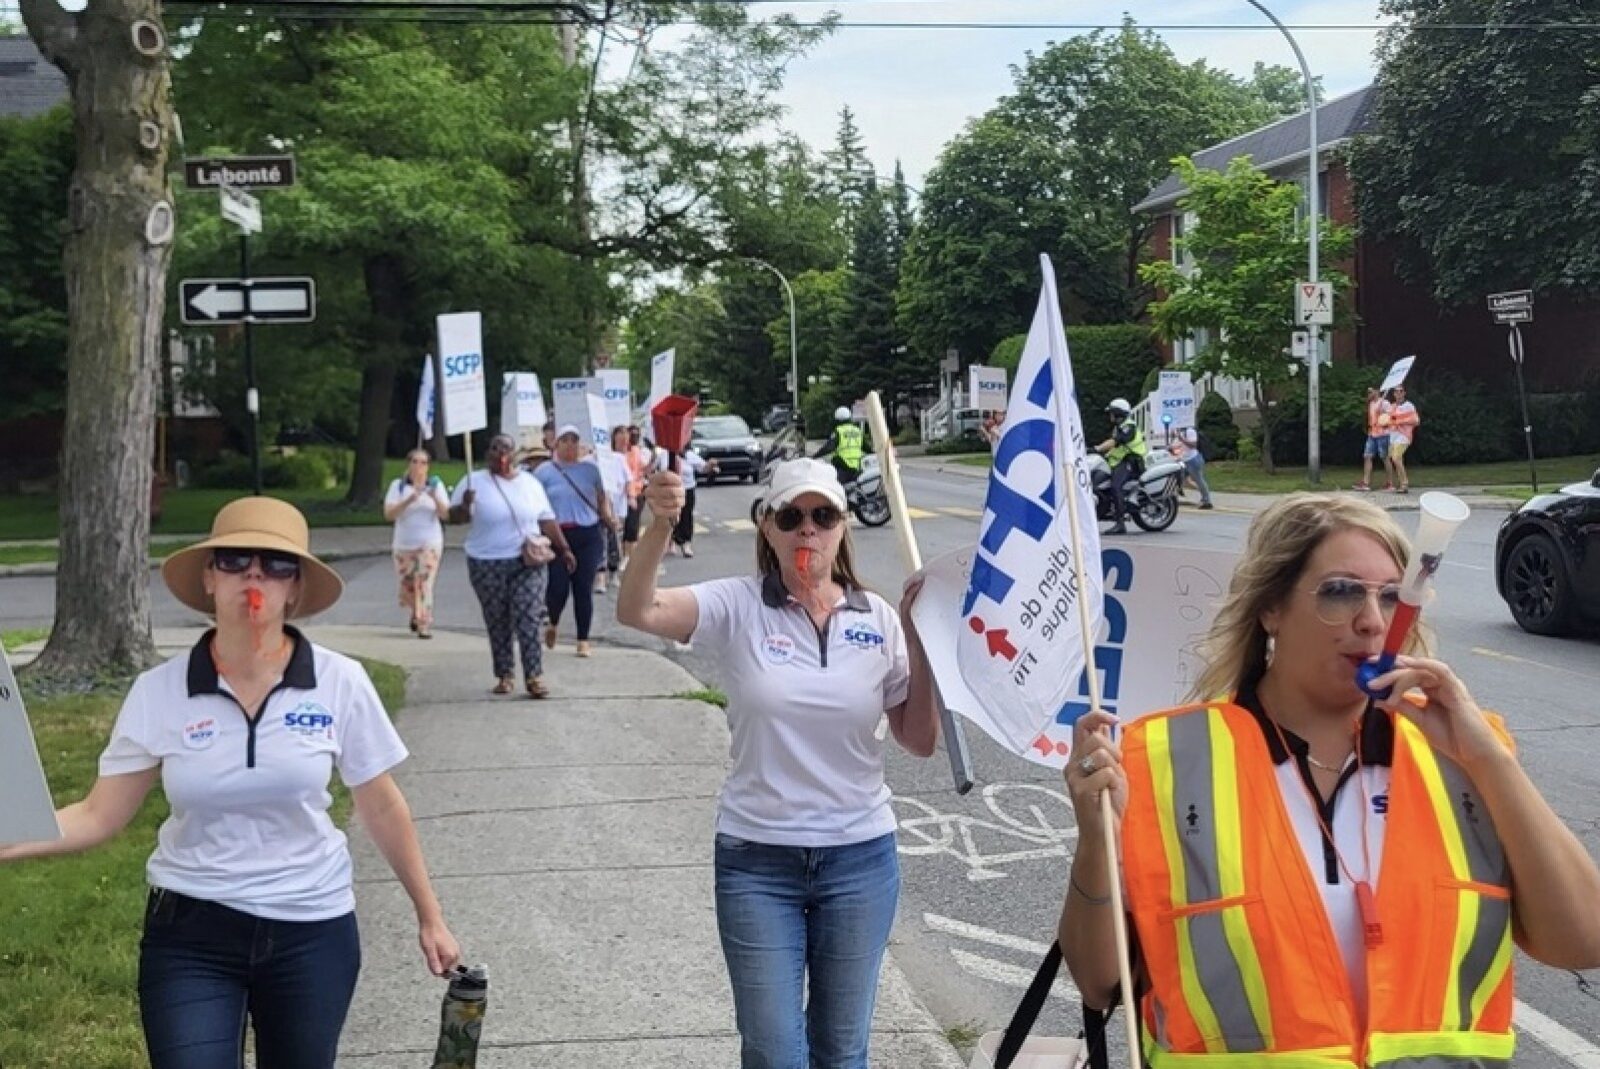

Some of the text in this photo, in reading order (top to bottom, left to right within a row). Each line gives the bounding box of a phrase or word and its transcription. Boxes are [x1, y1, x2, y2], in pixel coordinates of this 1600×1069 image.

[196, 165, 281, 185] Labonté
[445, 353, 481, 377] SCFP
[555, 381, 587, 391] SCFP
[978, 380, 1006, 391] SCFP
[605, 389, 628, 400] CFP
[1162, 397, 1193, 408] SCFP
[844, 628, 884, 645] SCFP
[284, 712, 334, 728] SCFP
